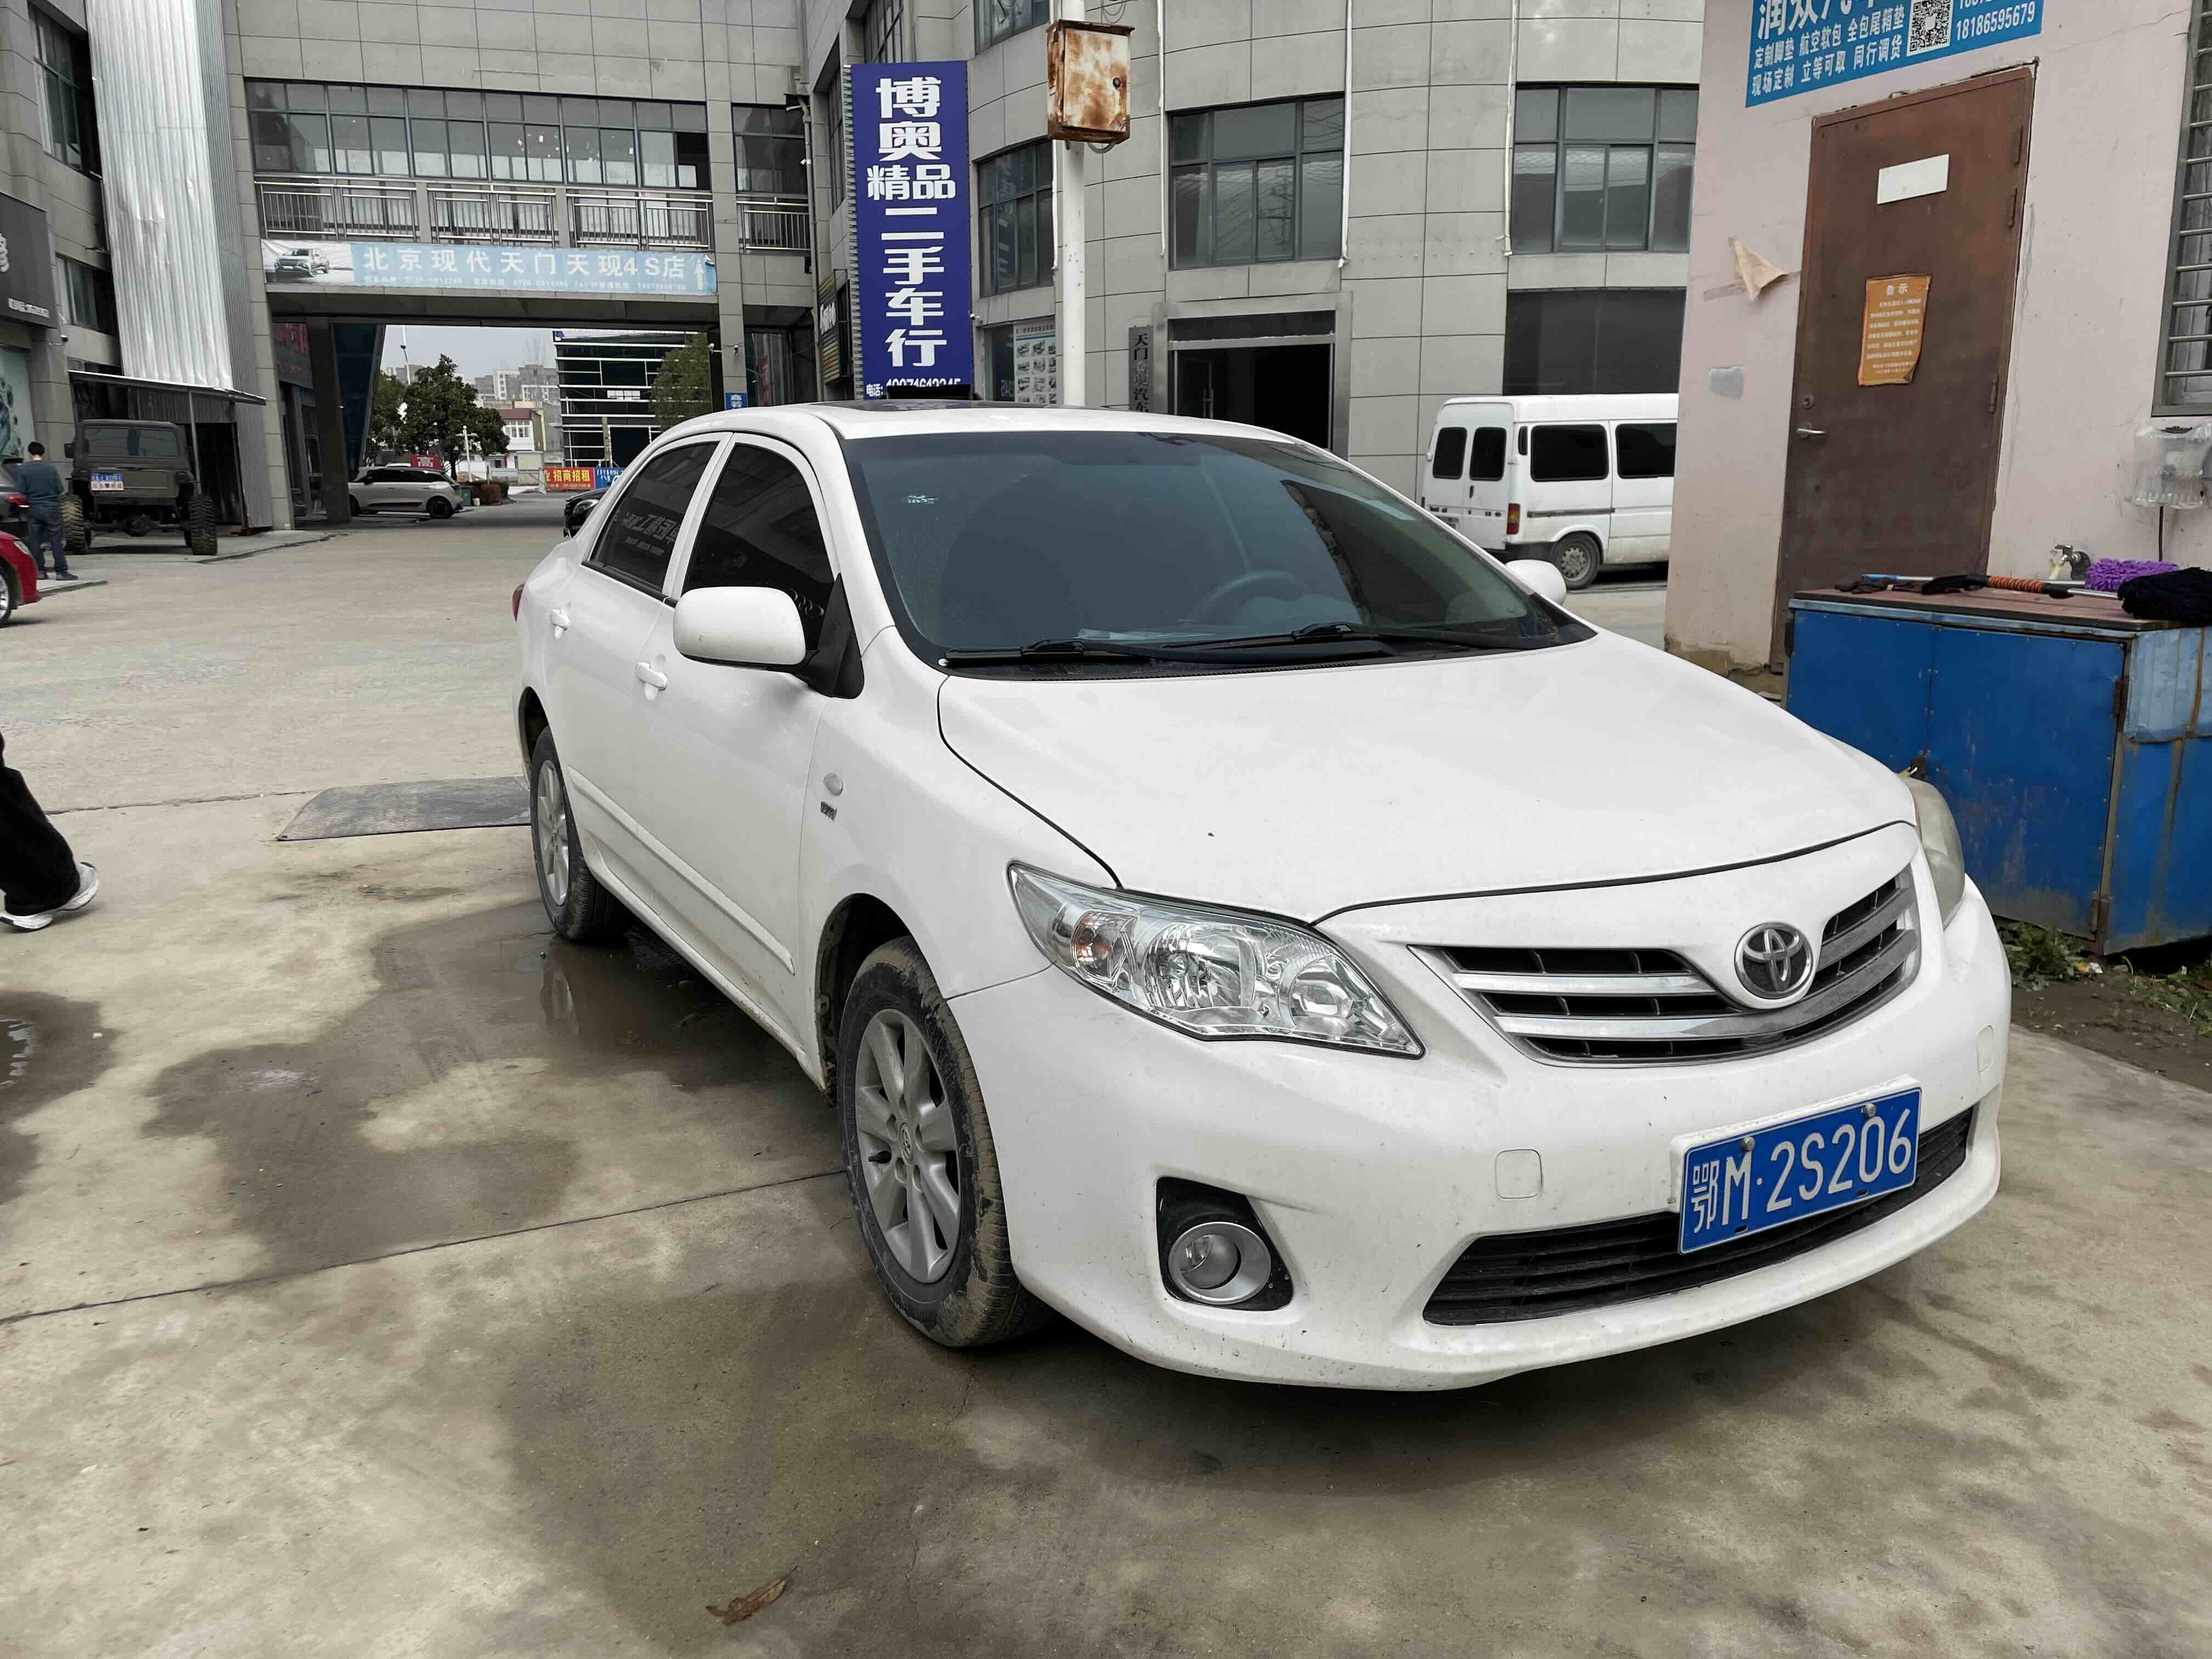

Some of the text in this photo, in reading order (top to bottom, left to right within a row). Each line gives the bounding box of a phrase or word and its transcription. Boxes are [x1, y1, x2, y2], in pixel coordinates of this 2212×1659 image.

[1754, 4, 1905, 70] 定制脚垫 航空软包 全包尾箱垫
[1956, 2, 2035, 41] 18186595679
[1751, 33, 1903, 97] 现场定制 立等可取 同行调货
